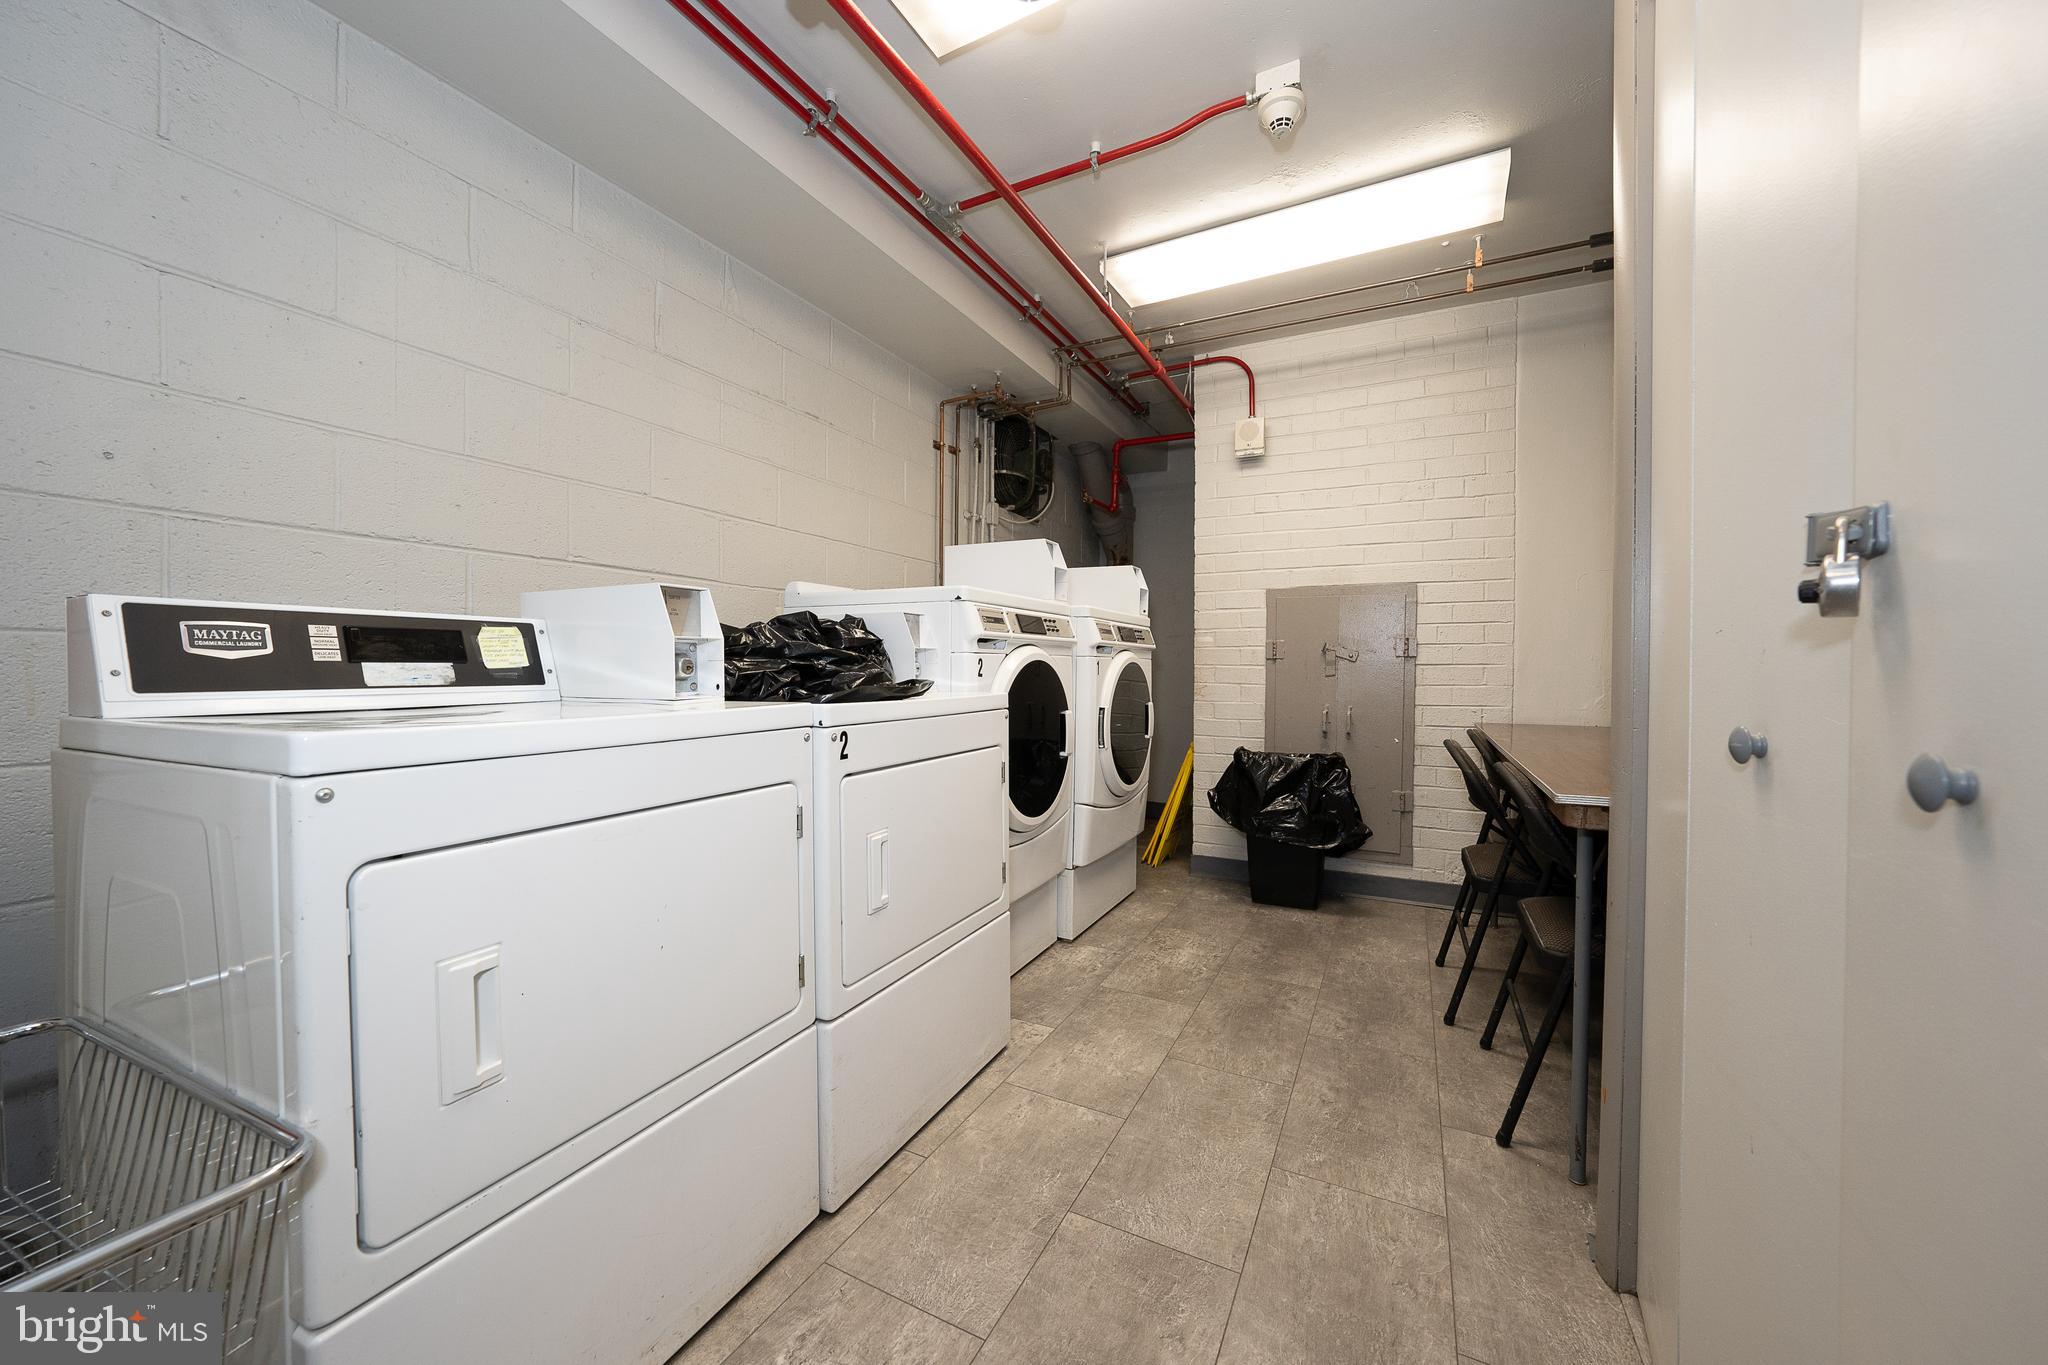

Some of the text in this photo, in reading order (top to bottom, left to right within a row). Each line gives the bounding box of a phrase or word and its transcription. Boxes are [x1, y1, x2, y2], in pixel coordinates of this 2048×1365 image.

[193, 629, 262, 641] MAYTAG
[977, 658, 983, 678] 2
[1096, 660, 1100, 676] 1
[839, 730, 849, 761] 2
